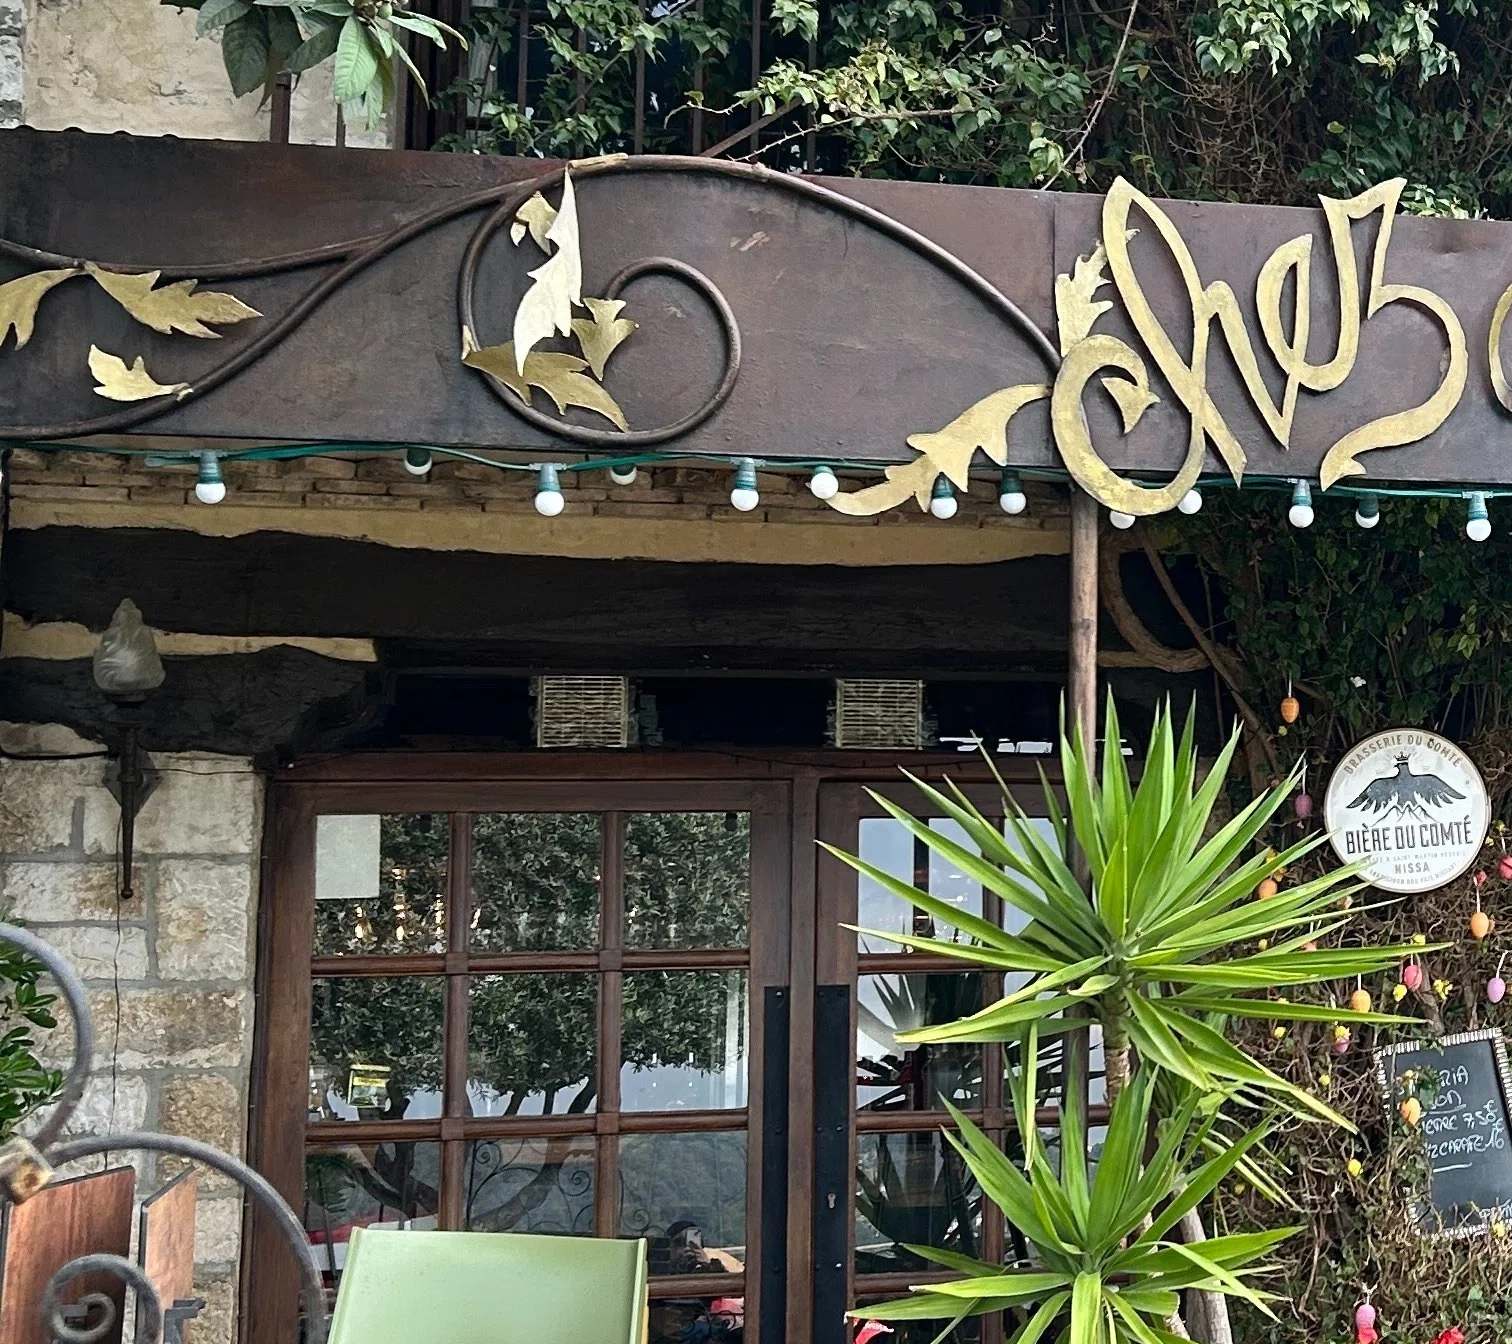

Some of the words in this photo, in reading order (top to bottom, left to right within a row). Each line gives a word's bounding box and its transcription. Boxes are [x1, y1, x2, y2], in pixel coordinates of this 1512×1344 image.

[1050, 174, 1467, 513] Chez
[1343, 734, 1403, 774] BRASSERIE
[1407, 735, 1423, 746] DU
[1345, 823, 1393, 855] BIÈRE
[1395, 825, 1416, 850] DU
[1419, 815, 1473, 848] COMTÉ
[1394, 861, 1431, 875] NISSA
